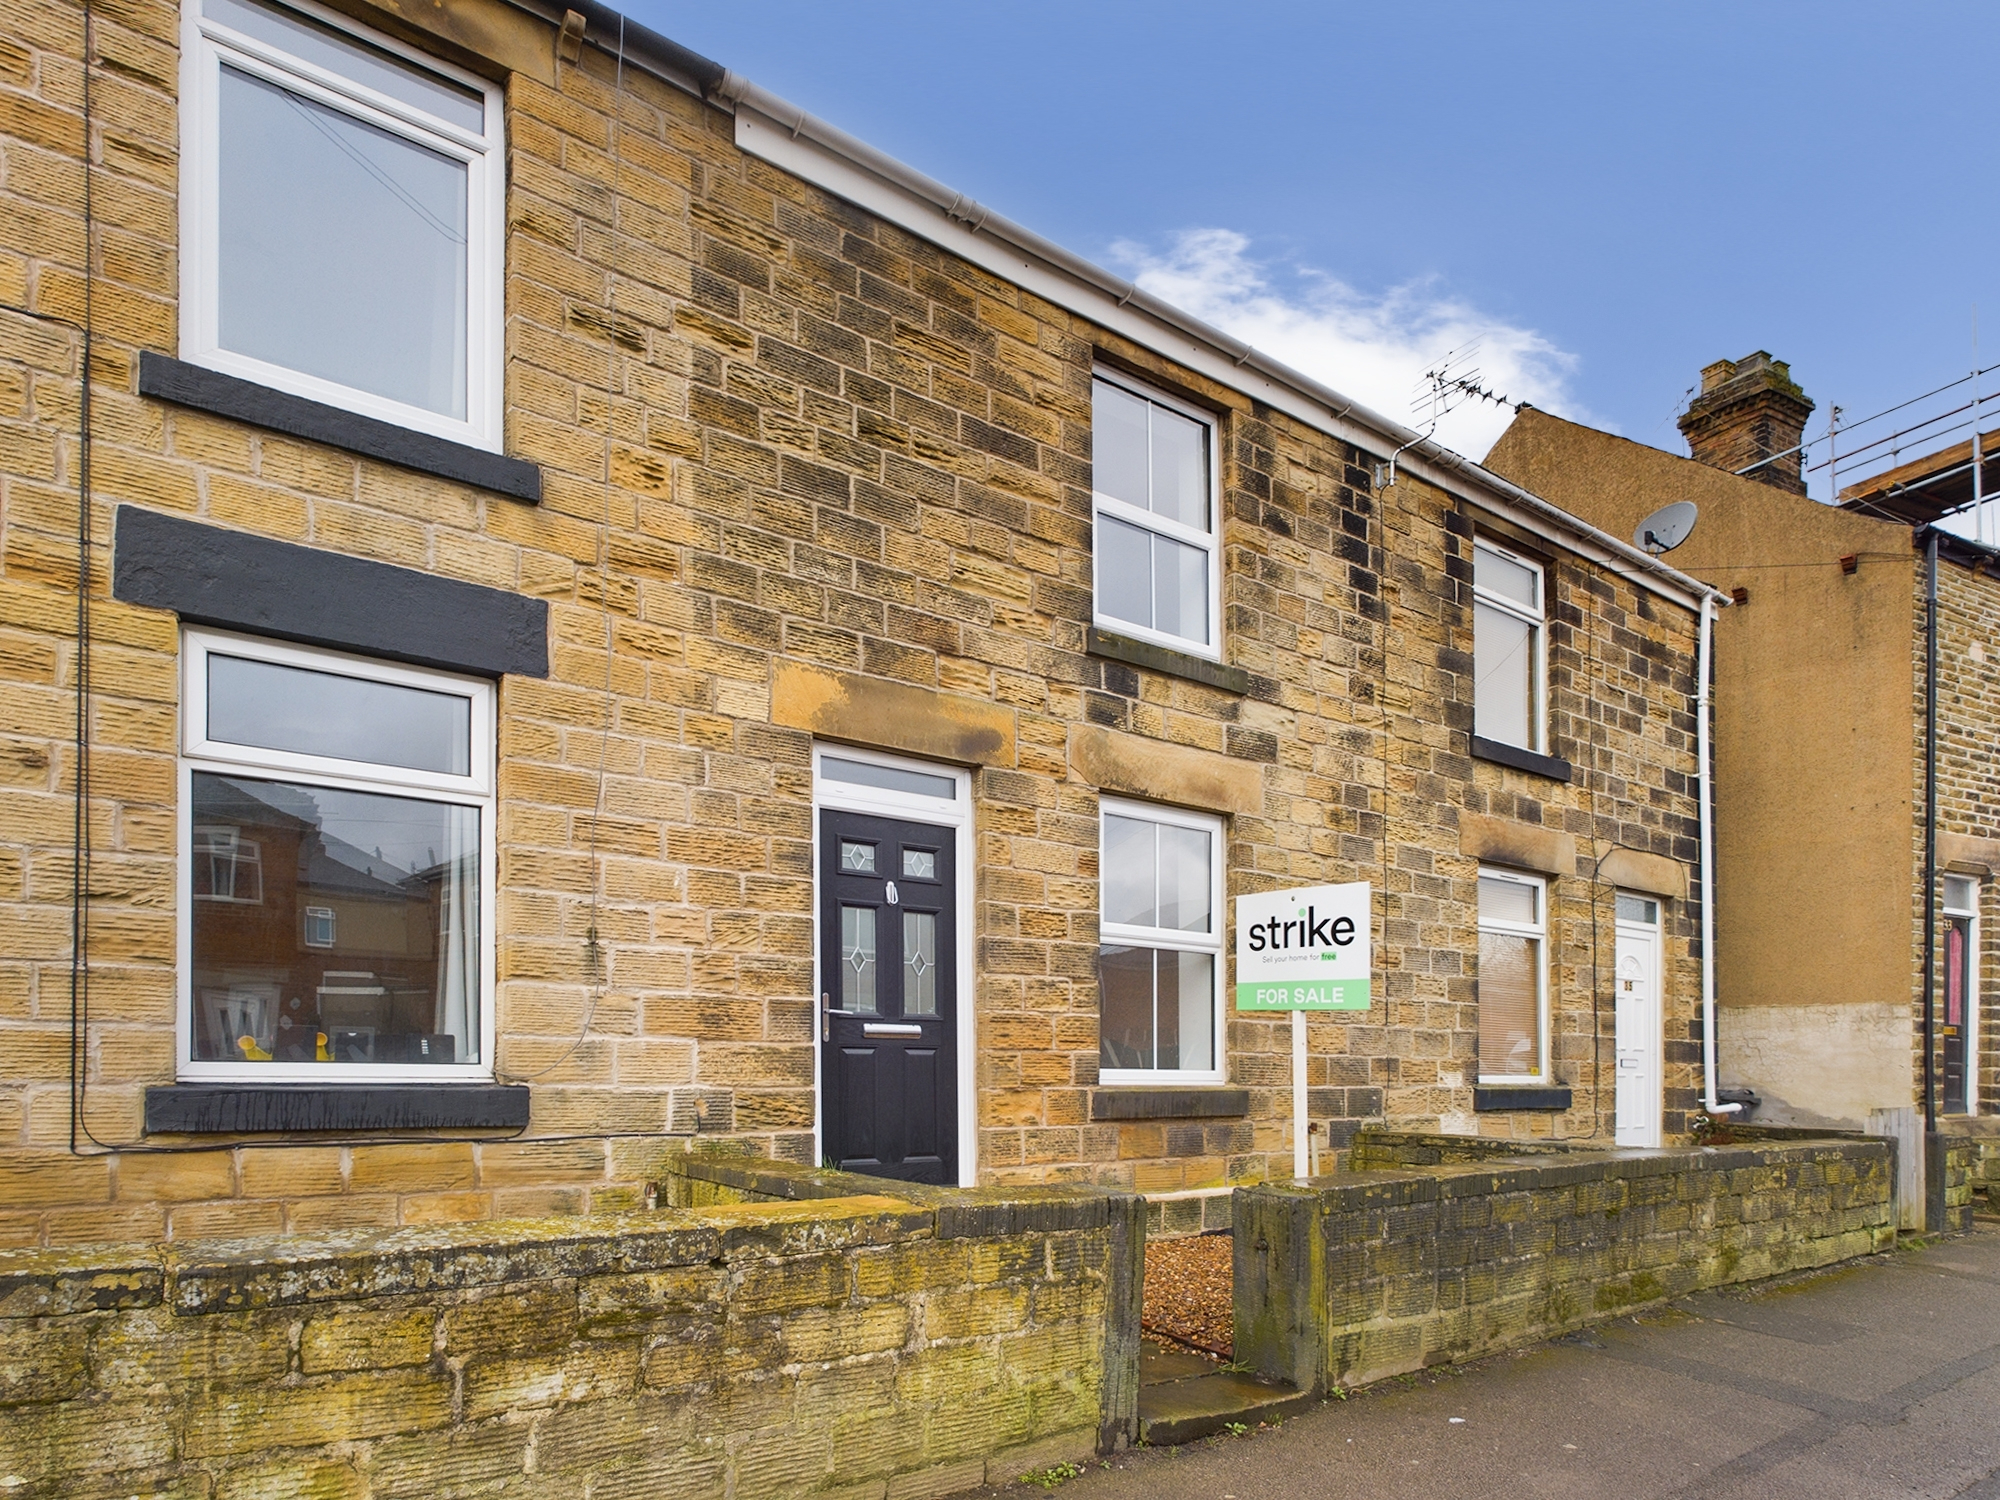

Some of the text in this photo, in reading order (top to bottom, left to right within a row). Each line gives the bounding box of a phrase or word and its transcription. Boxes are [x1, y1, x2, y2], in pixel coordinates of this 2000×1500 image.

[1249, 906, 1355, 951] strike
[1262, 952, 1337, 964] Sell your home for free
[1256, 987, 1344, 1004] FOR SALE
